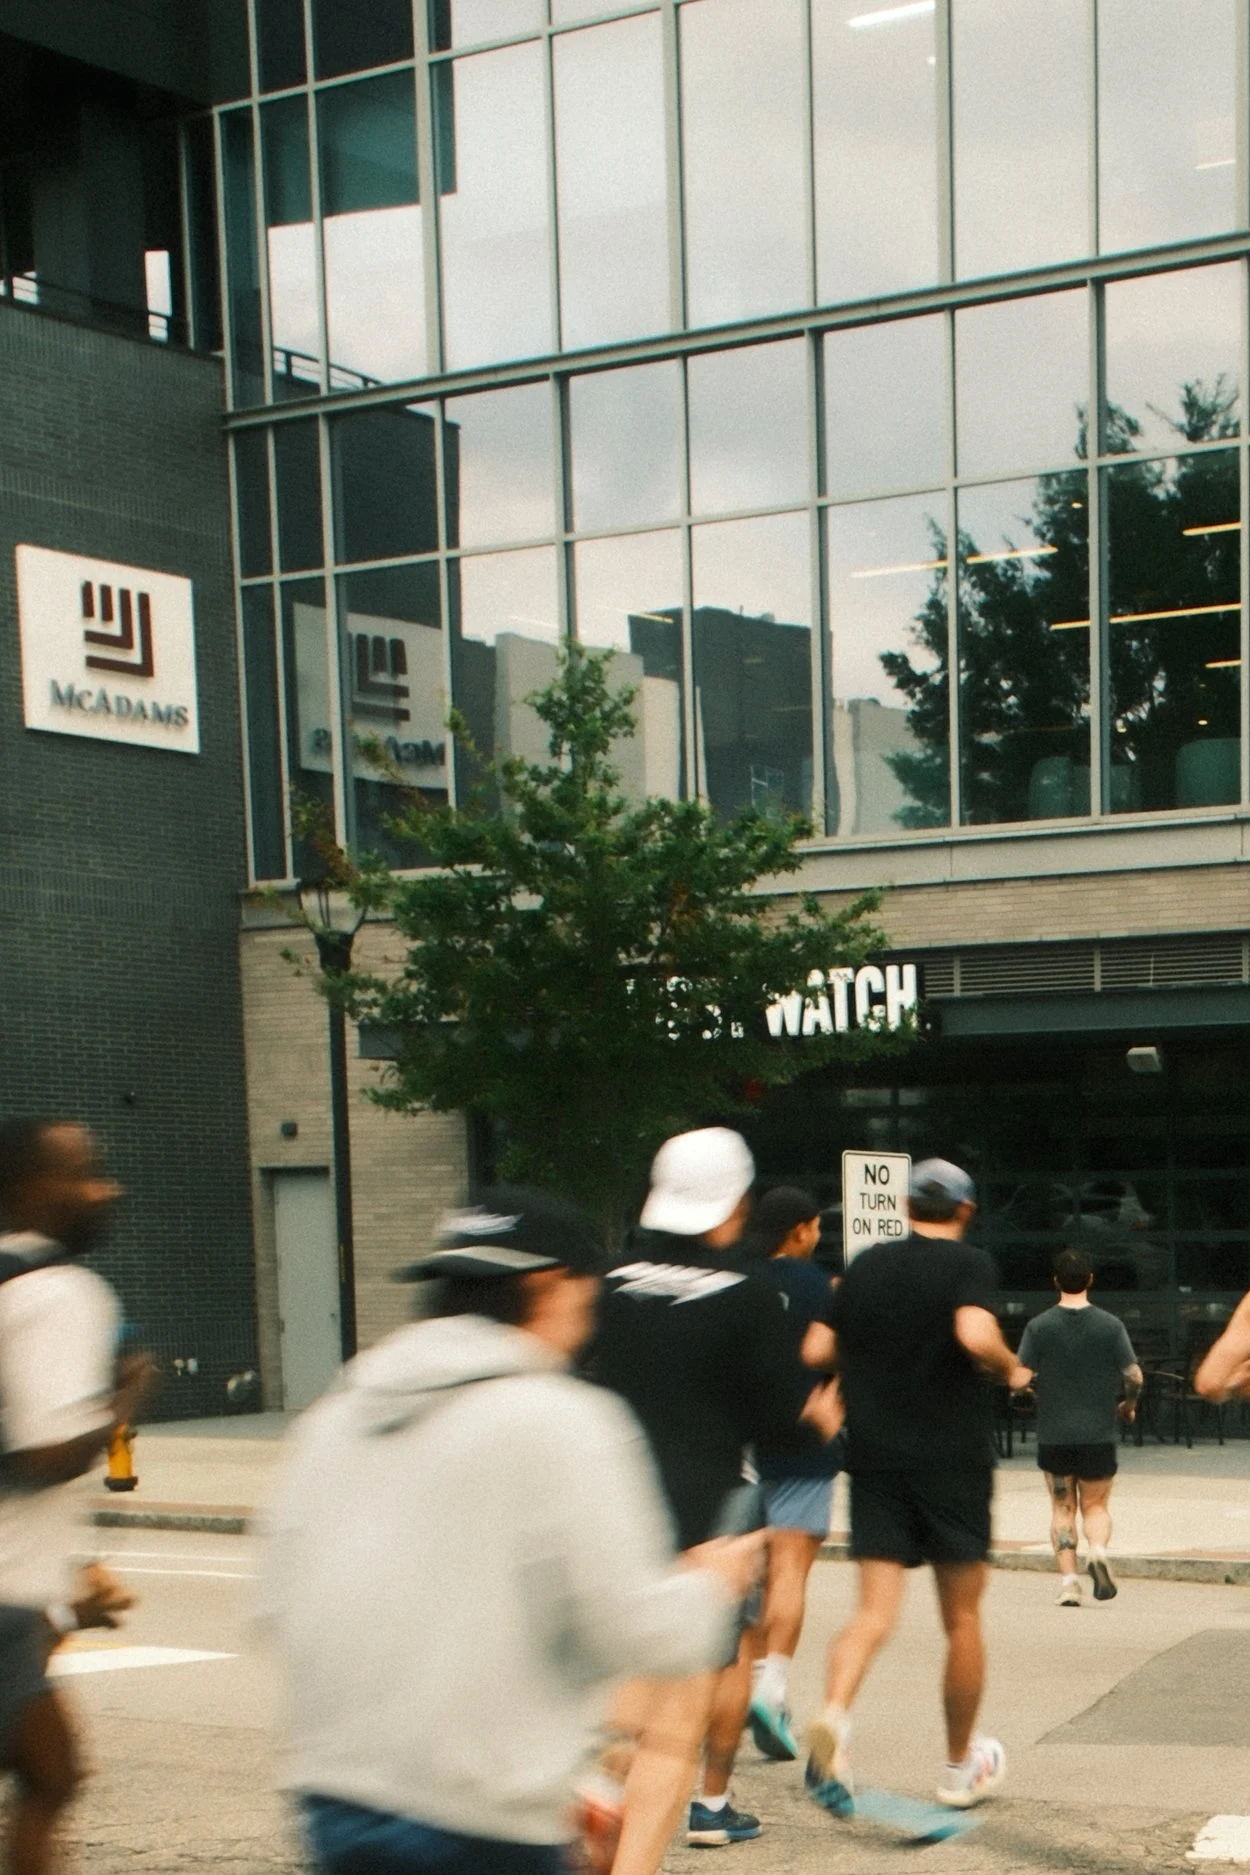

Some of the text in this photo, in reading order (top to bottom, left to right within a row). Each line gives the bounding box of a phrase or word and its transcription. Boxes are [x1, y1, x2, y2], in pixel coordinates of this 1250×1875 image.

[763, 963, 918, 1037] WATCH
[864, 1163, 890, 1185] NO
[859, 1192, 896, 1211] TURN
[852, 1217, 903, 1237] ON RED
